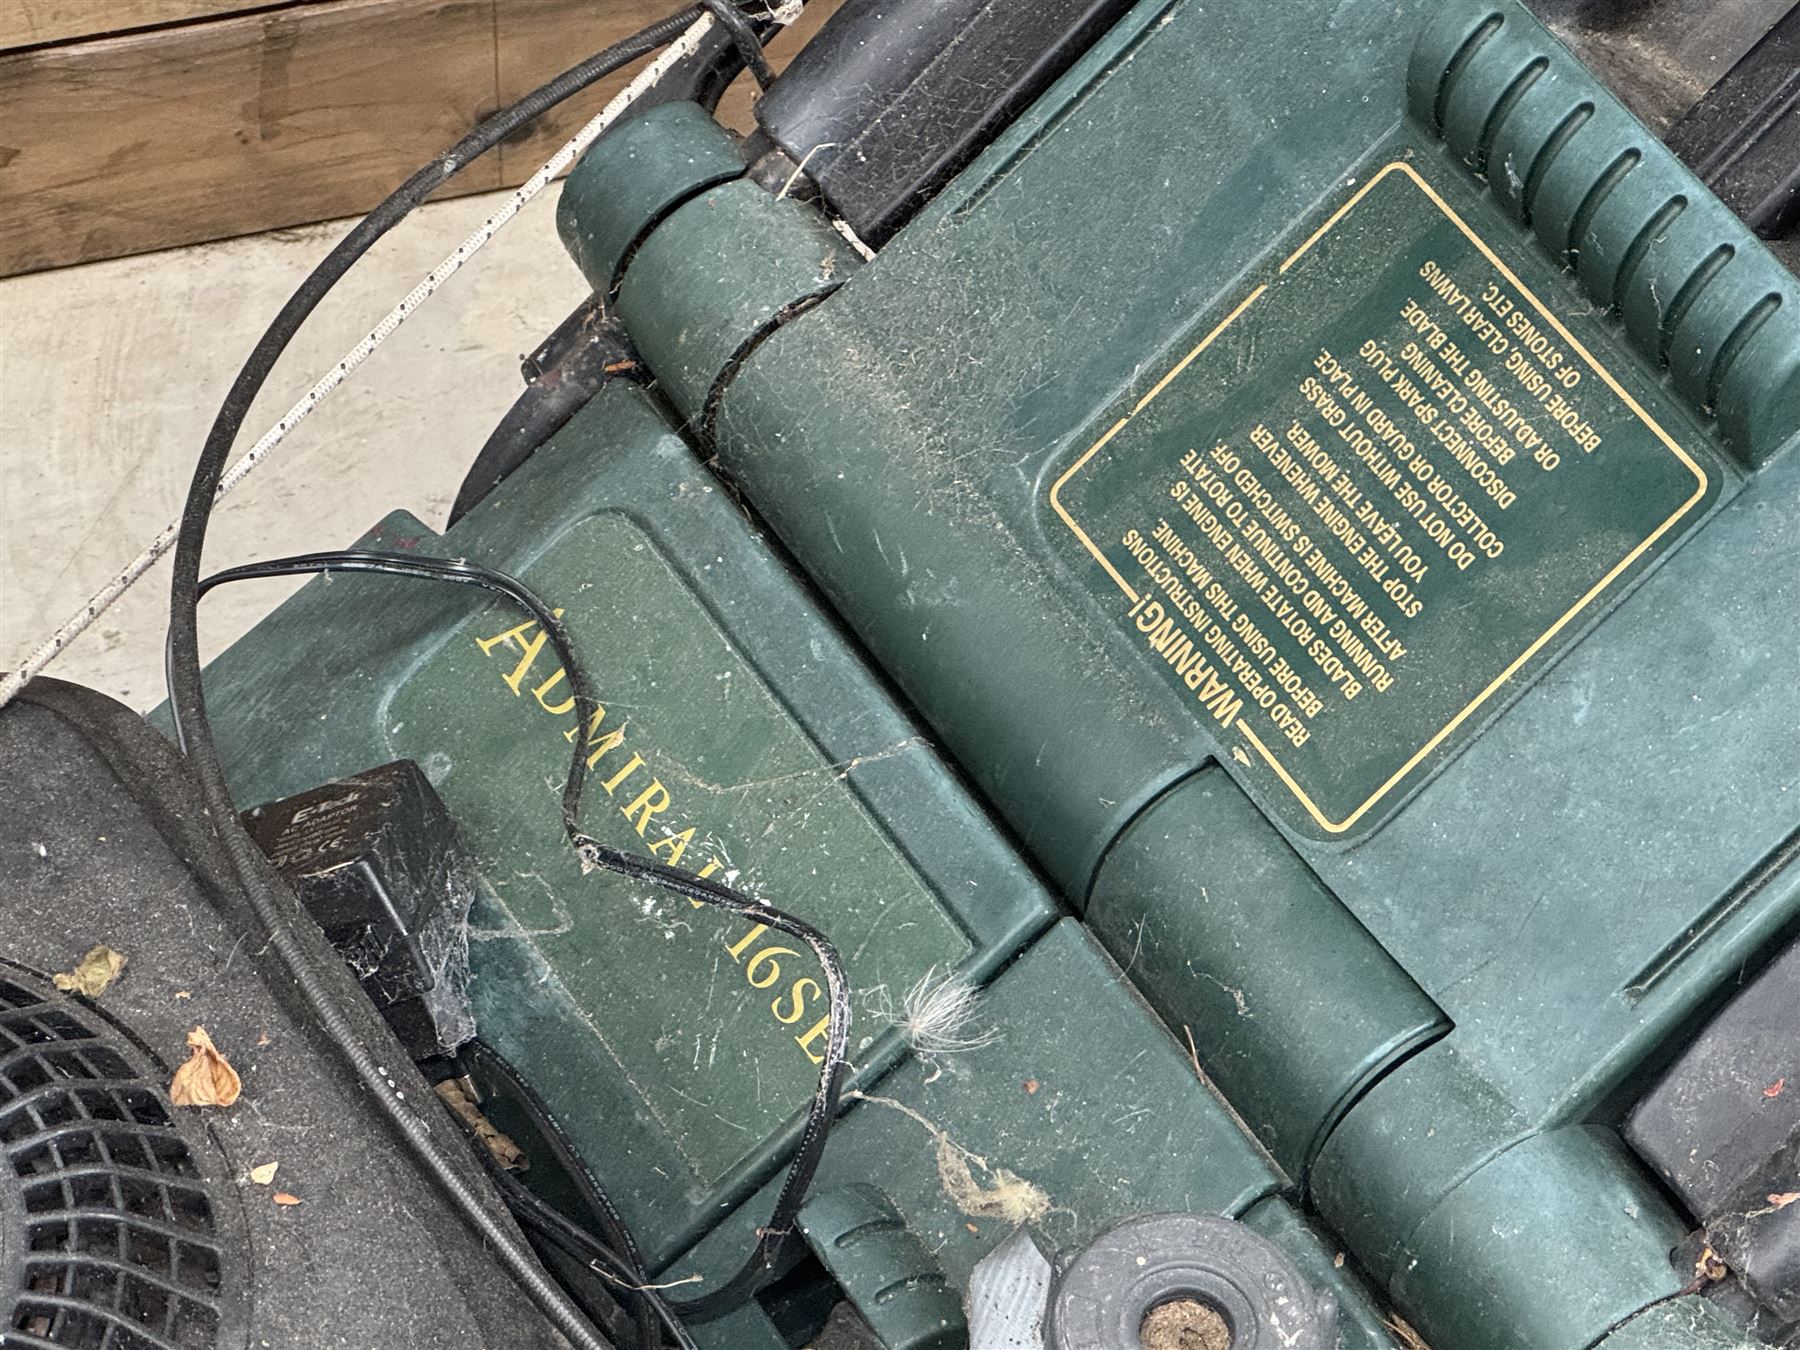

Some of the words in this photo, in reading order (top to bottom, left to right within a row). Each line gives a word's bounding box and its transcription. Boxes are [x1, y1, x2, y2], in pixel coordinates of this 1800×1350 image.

[1420, 261, 1471, 313] LAWNS
[1479, 280, 1513, 317] ETC.
[1398, 300, 1447, 348] BLADE.
[1461, 308, 1509, 353] CLEAR
[1506, 311, 1562, 369] STONES
[1311, 348, 1356, 398] PLACE.
[1359, 339, 1397, 380] PLUG
[1400, 342, 1468, 413] CLEANING
[1439, 343, 1469, 376] THE
[1504, 351, 1553, 400] USING,
[1555, 367, 1581, 388] OF
[1300, 377, 1346, 425] GRASS
[1352, 391, 1372, 412] IN
[1393, 374, 1437, 424] SPARK
[1463, 368, 1542, 449] ADJUSTING
[1545, 394, 1601, 452] BEFORE
[1207, 441, 1240, 473] OFF.
[1283, 418, 1339, 481] MOWER.
[1338, 425, 1401, 488] WITHOUT
[1365, 408, 1415, 460] GUARD
[1461, 407, 1514, 465] BEFORE
[1534, 443, 1560, 469] OR
[1180, 450, 1233, 507] ROTATE
[1249, 425, 1319, 504] WHENEVER
[1407, 454, 1433, 481] OR
[1430, 420, 1516, 508] DISCONNECT
[1170, 480, 1188, 500] IS
[1225, 501, 1248, 527] TO
[1233, 468, 1301, 541] SWITCHED
[1331, 474, 1361, 508] THE
[1394, 481, 1425, 516] USE
[1183, 495, 1233, 551] ENGINE
[1313, 496, 1366, 554] ENGINE
[1355, 500, 1402, 552] LEAVE
[1418, 511, 1451, 547] NOT
[1427, 476, 1504, 558] COLLECTOR
[1150, 520, 1212, 589] MACHINE.
[1224, 543, 1268, 591] WHEN
[1241, 520, 1309, 594] CONTINUE
[1292, 535, 1313, 557] IS
[1357, 547, 1389, 581] THE
[1394, 544, 1426, 581] YOU
[1447, 541, 1474, 569] DO
[1122, 529, 1211, 631] INSTRUCTIONS
[1204, 582, 1236, 620] THIS
[1304, 549, 1366, 618] MACHINE
[1382, 579, 1421, 617] STOP
[1262, 585, 1314, 645] ROTATE
[1302, 590, 1334, 625] AND
[1129, 593, 1243, 727] WARNING!
[1231, 613, 1276, 664] USING
[1328, 619, 1393, 692] RUNNING
[1359, 611, 1405, 661] AFTER
[1204, 624, 1277, 708] OPERATING
[1268, 658, 1324, 717] BEFORE
[1308, 639, 1361, 699] BLADES
[1270, 703, 1309, 747] READ
